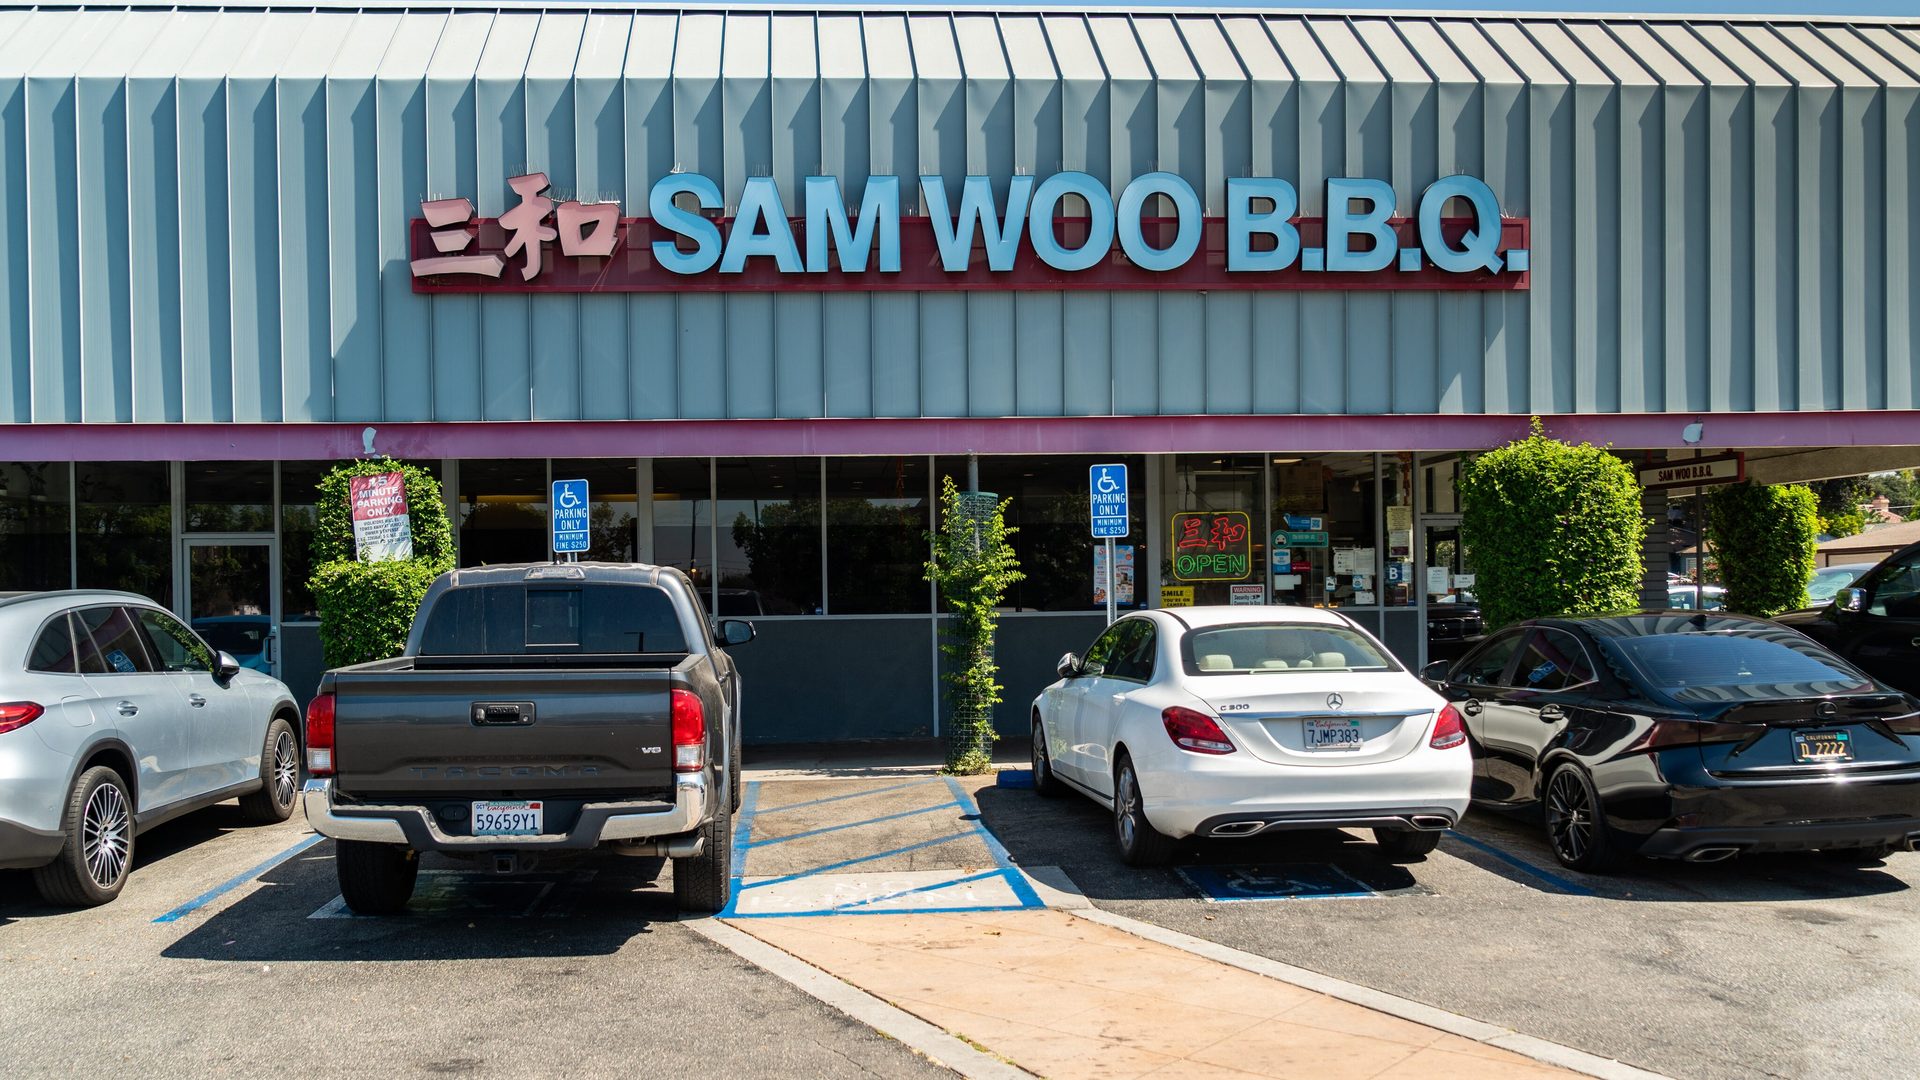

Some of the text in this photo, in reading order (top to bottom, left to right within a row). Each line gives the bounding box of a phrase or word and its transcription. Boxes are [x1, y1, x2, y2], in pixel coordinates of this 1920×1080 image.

[410, 172, 620, 281] 三和
[650, 170, 1529, 274] SAM WOO B.B.Q.
[1659, 465, 1713, 481] SAM WOO B.B.Q.
[368, 475, 388, 487] 15
[359, 486, 399, 498] MINUTE
[357, 495, 403, 508] PARKING
[1092, 493, 1126, 504] PARKING
[367, 506, 393, 517] ONLY
[554, 507, 587, 519] PARKING
[1099, 504, 1119, 515] ONLY
[561, 519, 580, 530] ONLY
[1097, 518, 1122, 526] MINIMUM
[1109, 526, 1126, 534] $250
[1179, 517, 1246, 550] 三和
[559, 533, 583, 541] MINIMUM
[571, 540, 587, 549] $250
[1177, 554, 1246, 574] OPEN
[1389, 567, 1399, 580] B
[488, 706, 519, 714] TOYOTA
[1308, 729, 1359, 743] 7JMP383
[410, 765, 599, 778] TACOMA
[477, 814, 538, 830] 59659Y1
